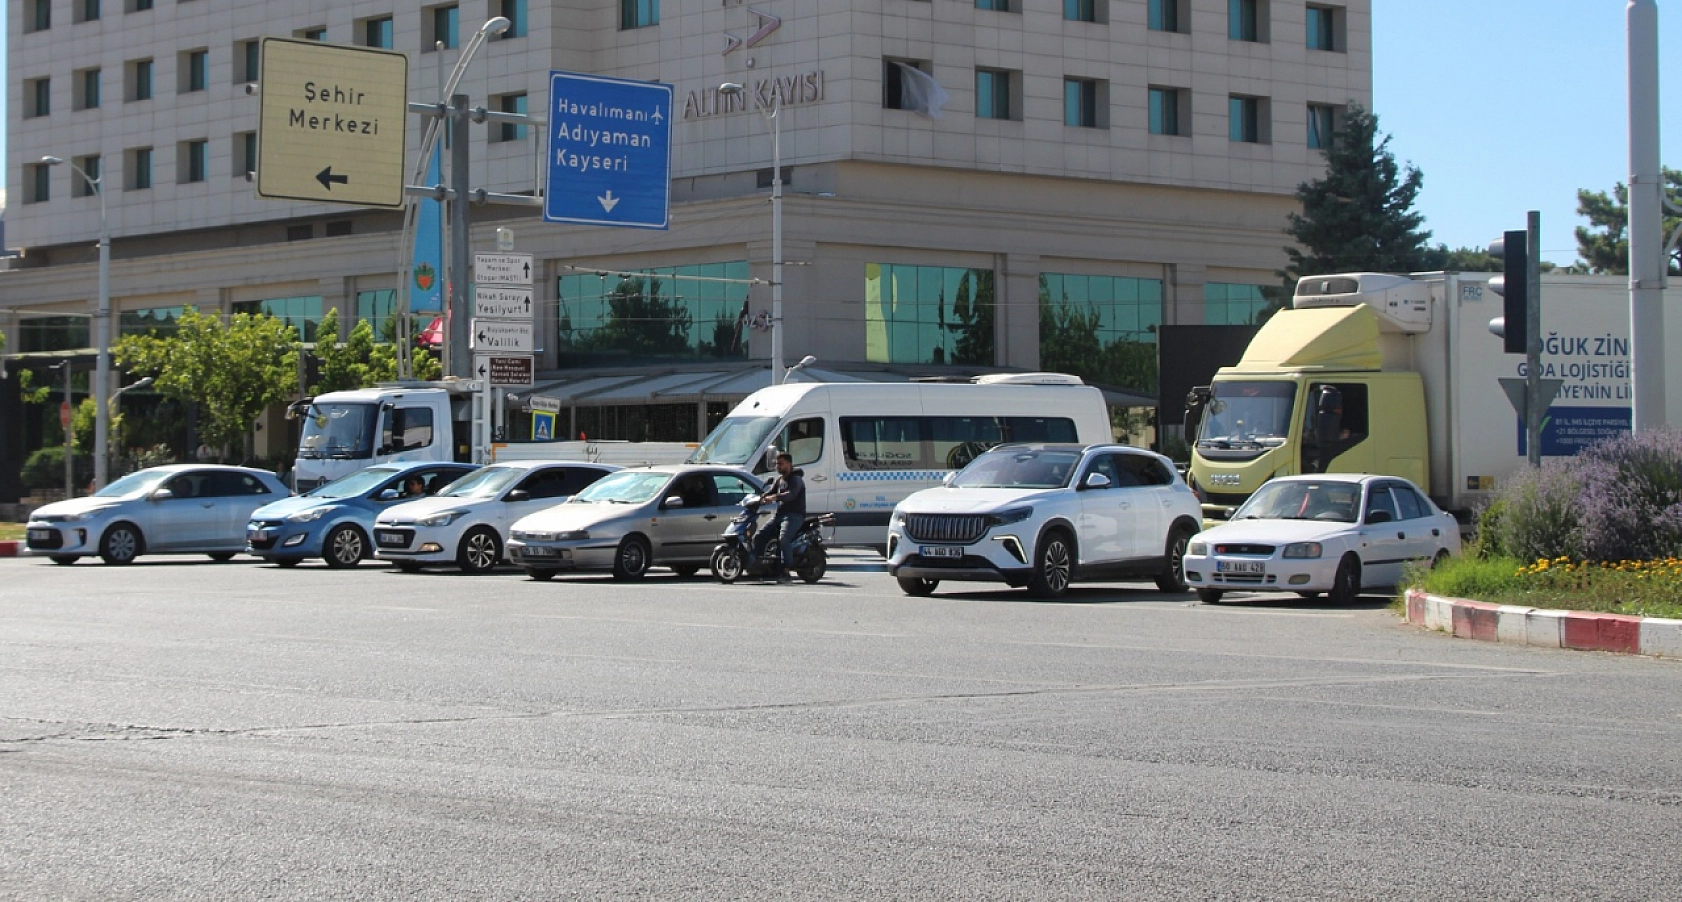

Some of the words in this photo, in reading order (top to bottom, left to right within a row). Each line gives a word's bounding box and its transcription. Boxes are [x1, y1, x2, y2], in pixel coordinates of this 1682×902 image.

[304, 81, 365, 105] Şehir
[684, 82, 746, 119] ALTIN
[754, 70, 825, 109] KAYISI
[289, 108, 378, 135] Merkezi
[558, 121, 651, 147] Adıyaman
[556, 148, 627, 172] Kayseri
[487, 337, 520, 347] Valilik
[1539, 331, 1589, 355] ĞUK
[1594, 333, 1628, 356] ZİN
[1517, 361, 1556, 377] GA
[1560, 360, 1630, 381] LOJİSTİĞİ
